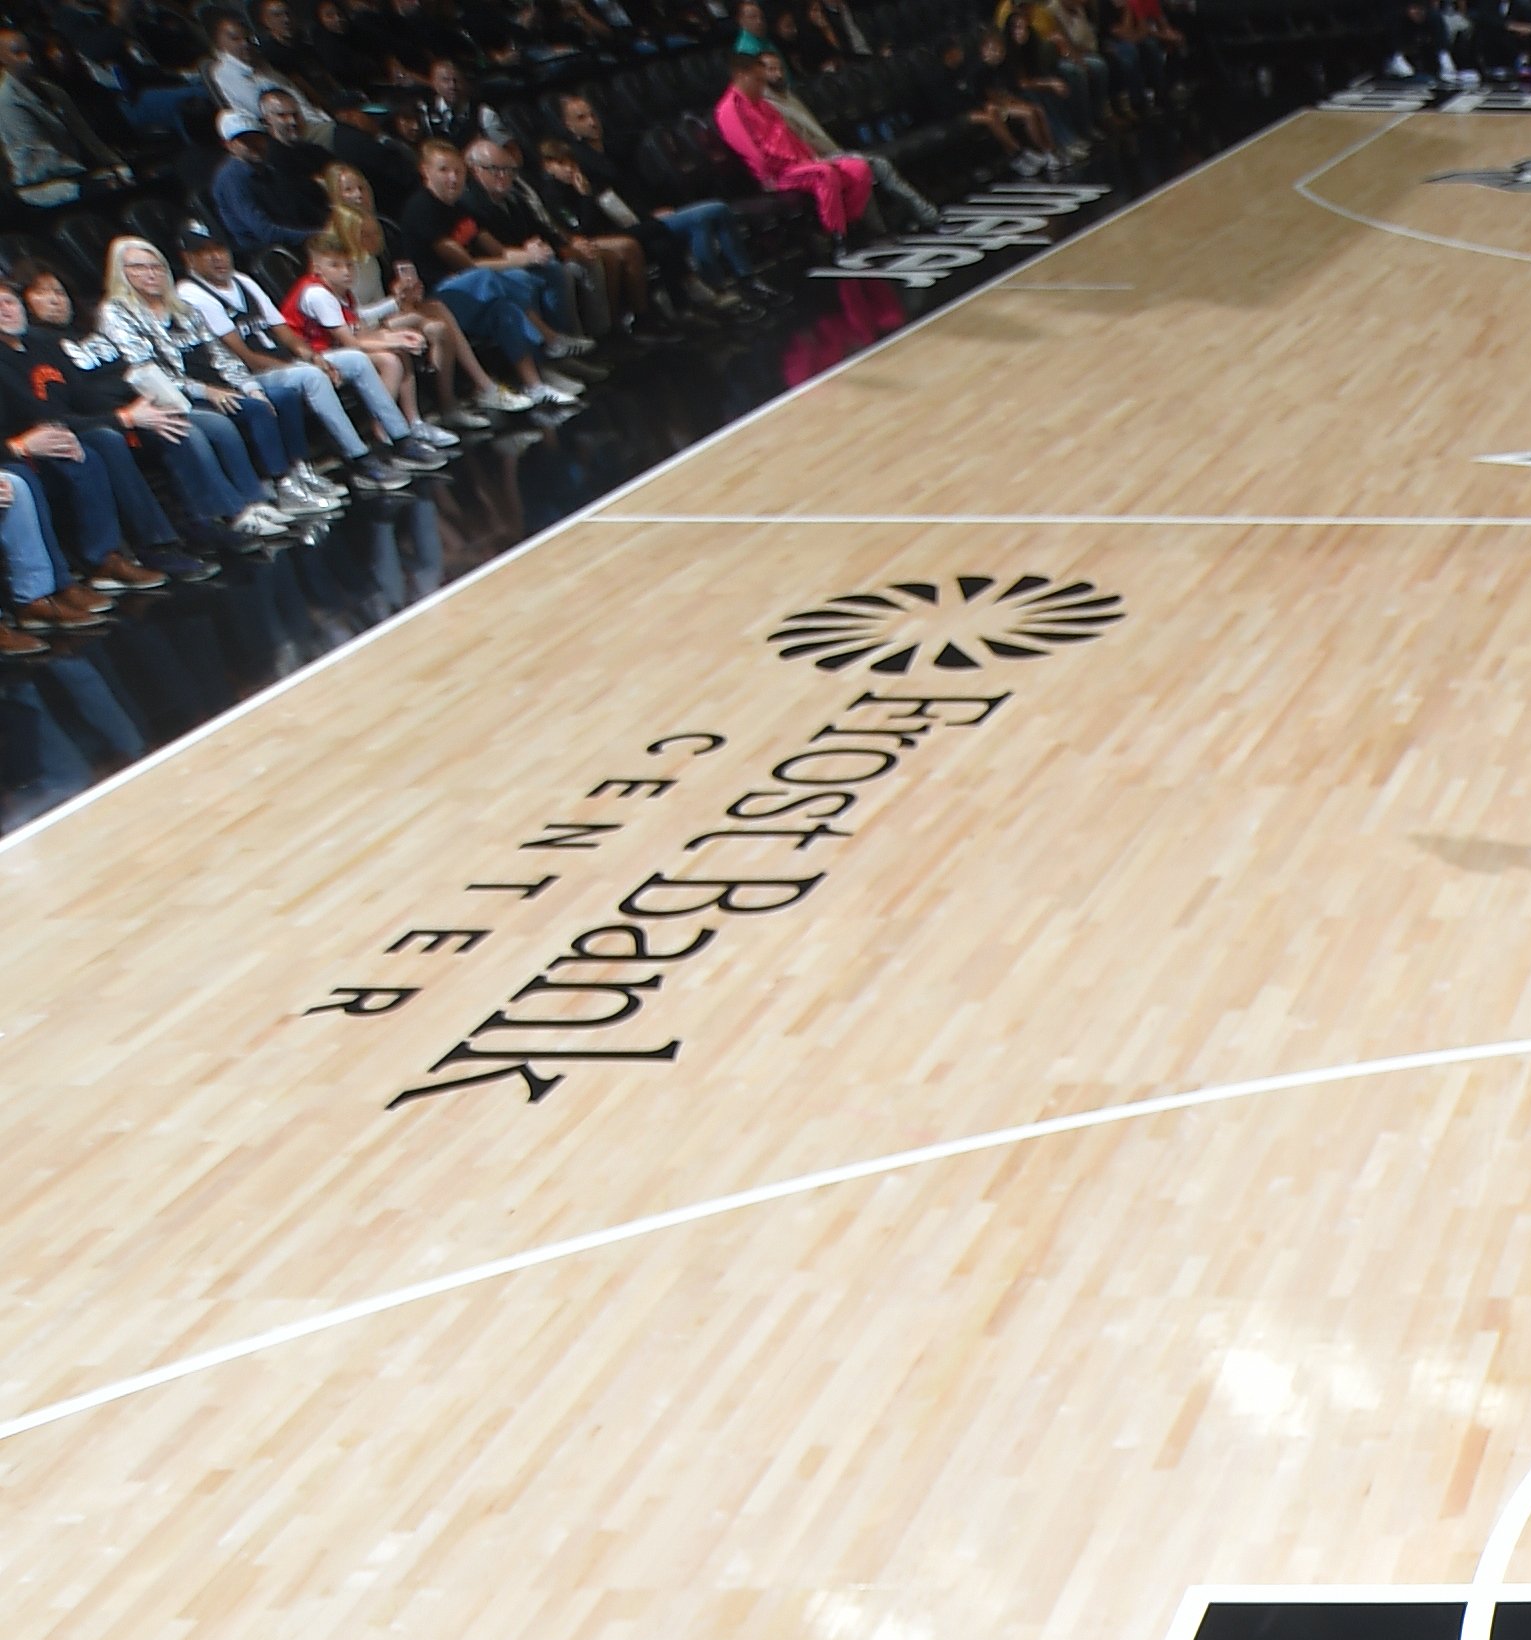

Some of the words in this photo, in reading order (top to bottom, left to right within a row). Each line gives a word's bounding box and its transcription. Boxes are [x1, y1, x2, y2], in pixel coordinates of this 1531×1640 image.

[807, 182, 1113, 289] meter
[684, 690, 1012, 854] Frost
[301, 731, 727, 1018] CENTER
[384, 871, 828, 1112] Bank
